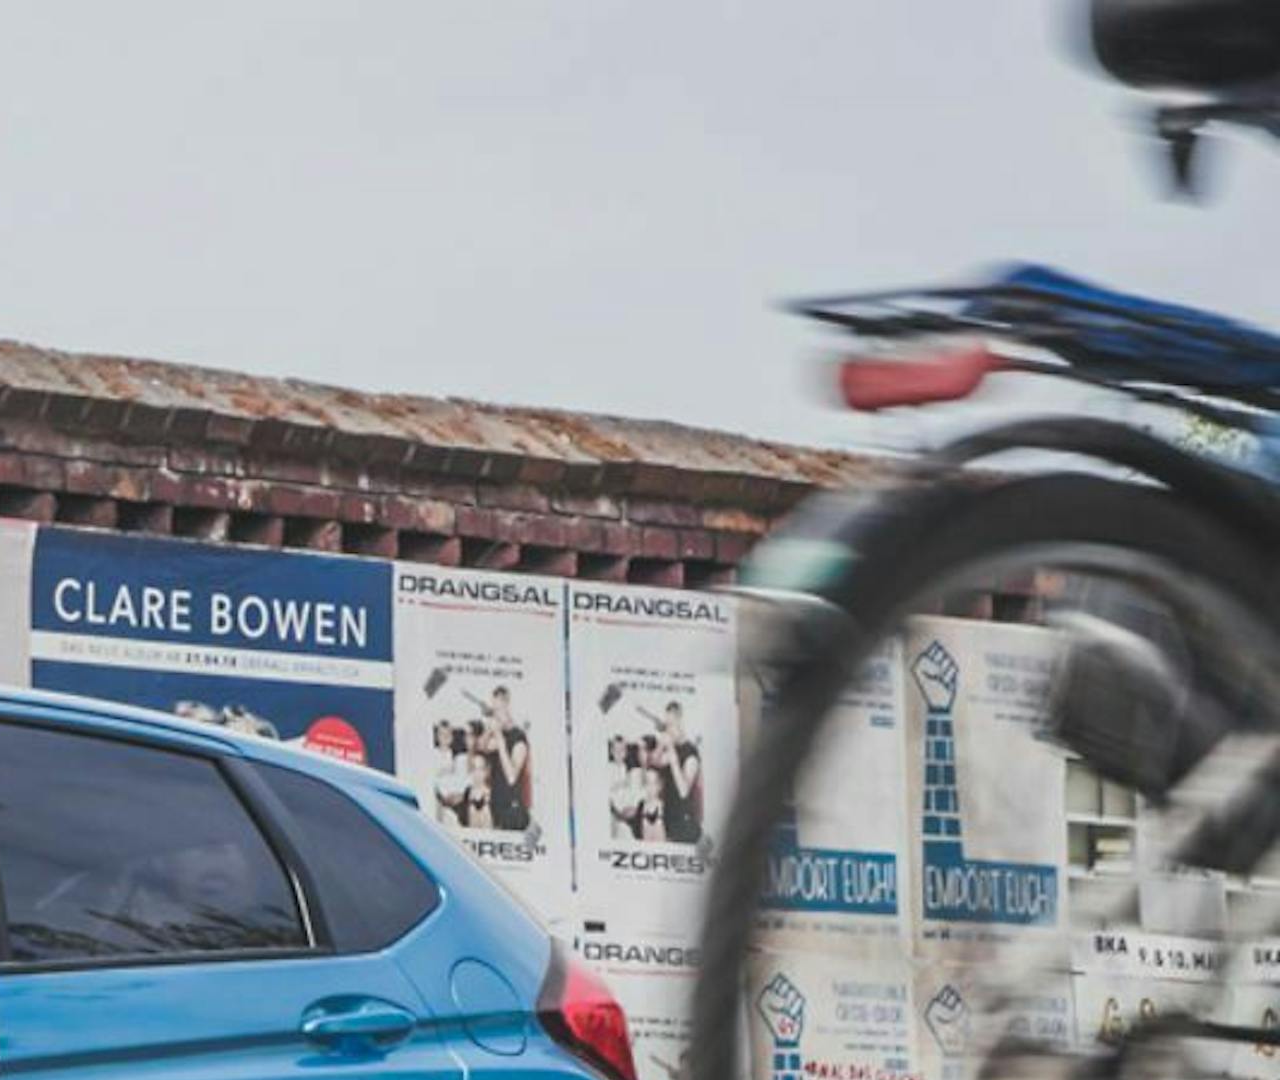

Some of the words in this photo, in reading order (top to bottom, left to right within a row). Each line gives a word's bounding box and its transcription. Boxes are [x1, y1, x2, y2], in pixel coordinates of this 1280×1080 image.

[398, 574, 560, 606] DRANGSAL
[572, 592, 730, 624] DRANGSAL
[53, 577, 192, 632] CLARE
[210, 593, 368, 648] BOWEN
[924, 864, 1002, 912] EMPÖRT
